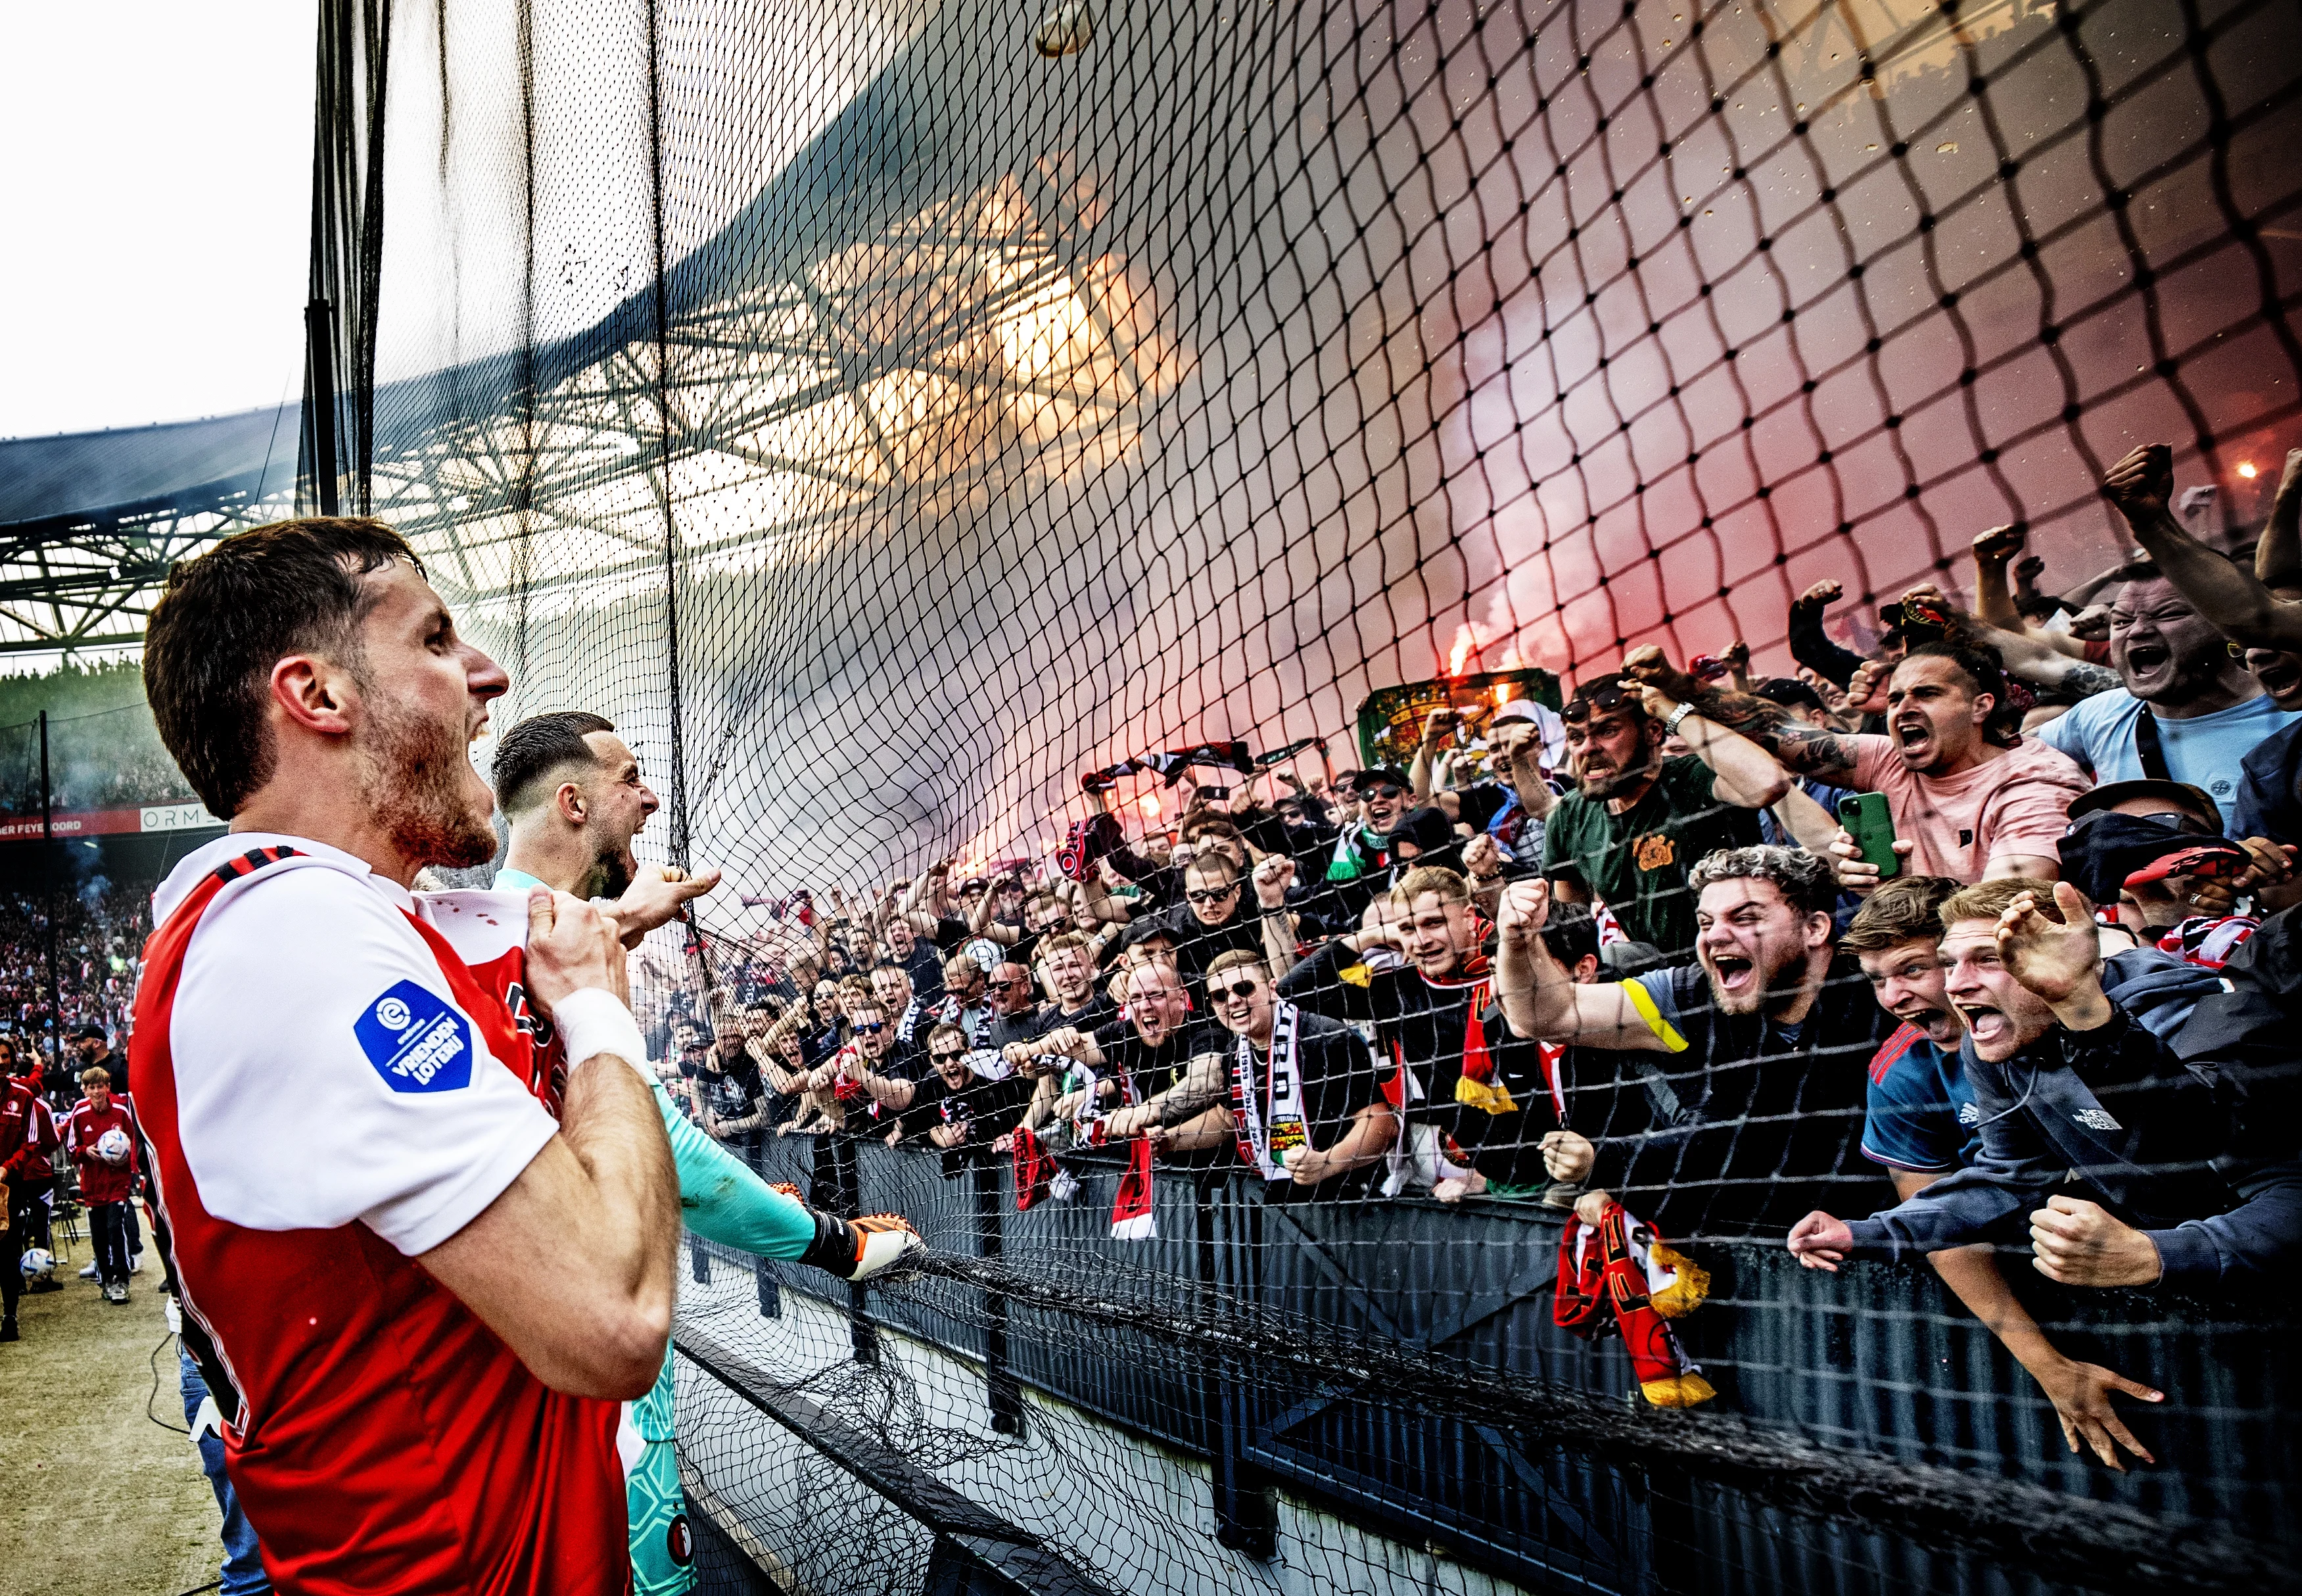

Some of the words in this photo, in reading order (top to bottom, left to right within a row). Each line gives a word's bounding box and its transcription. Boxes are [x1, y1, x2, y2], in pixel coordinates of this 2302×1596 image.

[17, 820, 82, 834] FEYEOORD
[391, 1016, 459, 1077] VRIENDEN
[412, 1034, 465, 1086] LOTERIJ
[1244, 1091, 1253, 1116] 2017
[2079, 1108, 2101, 1117] THE
[2086, 1121, 2114, 1130] FACE
